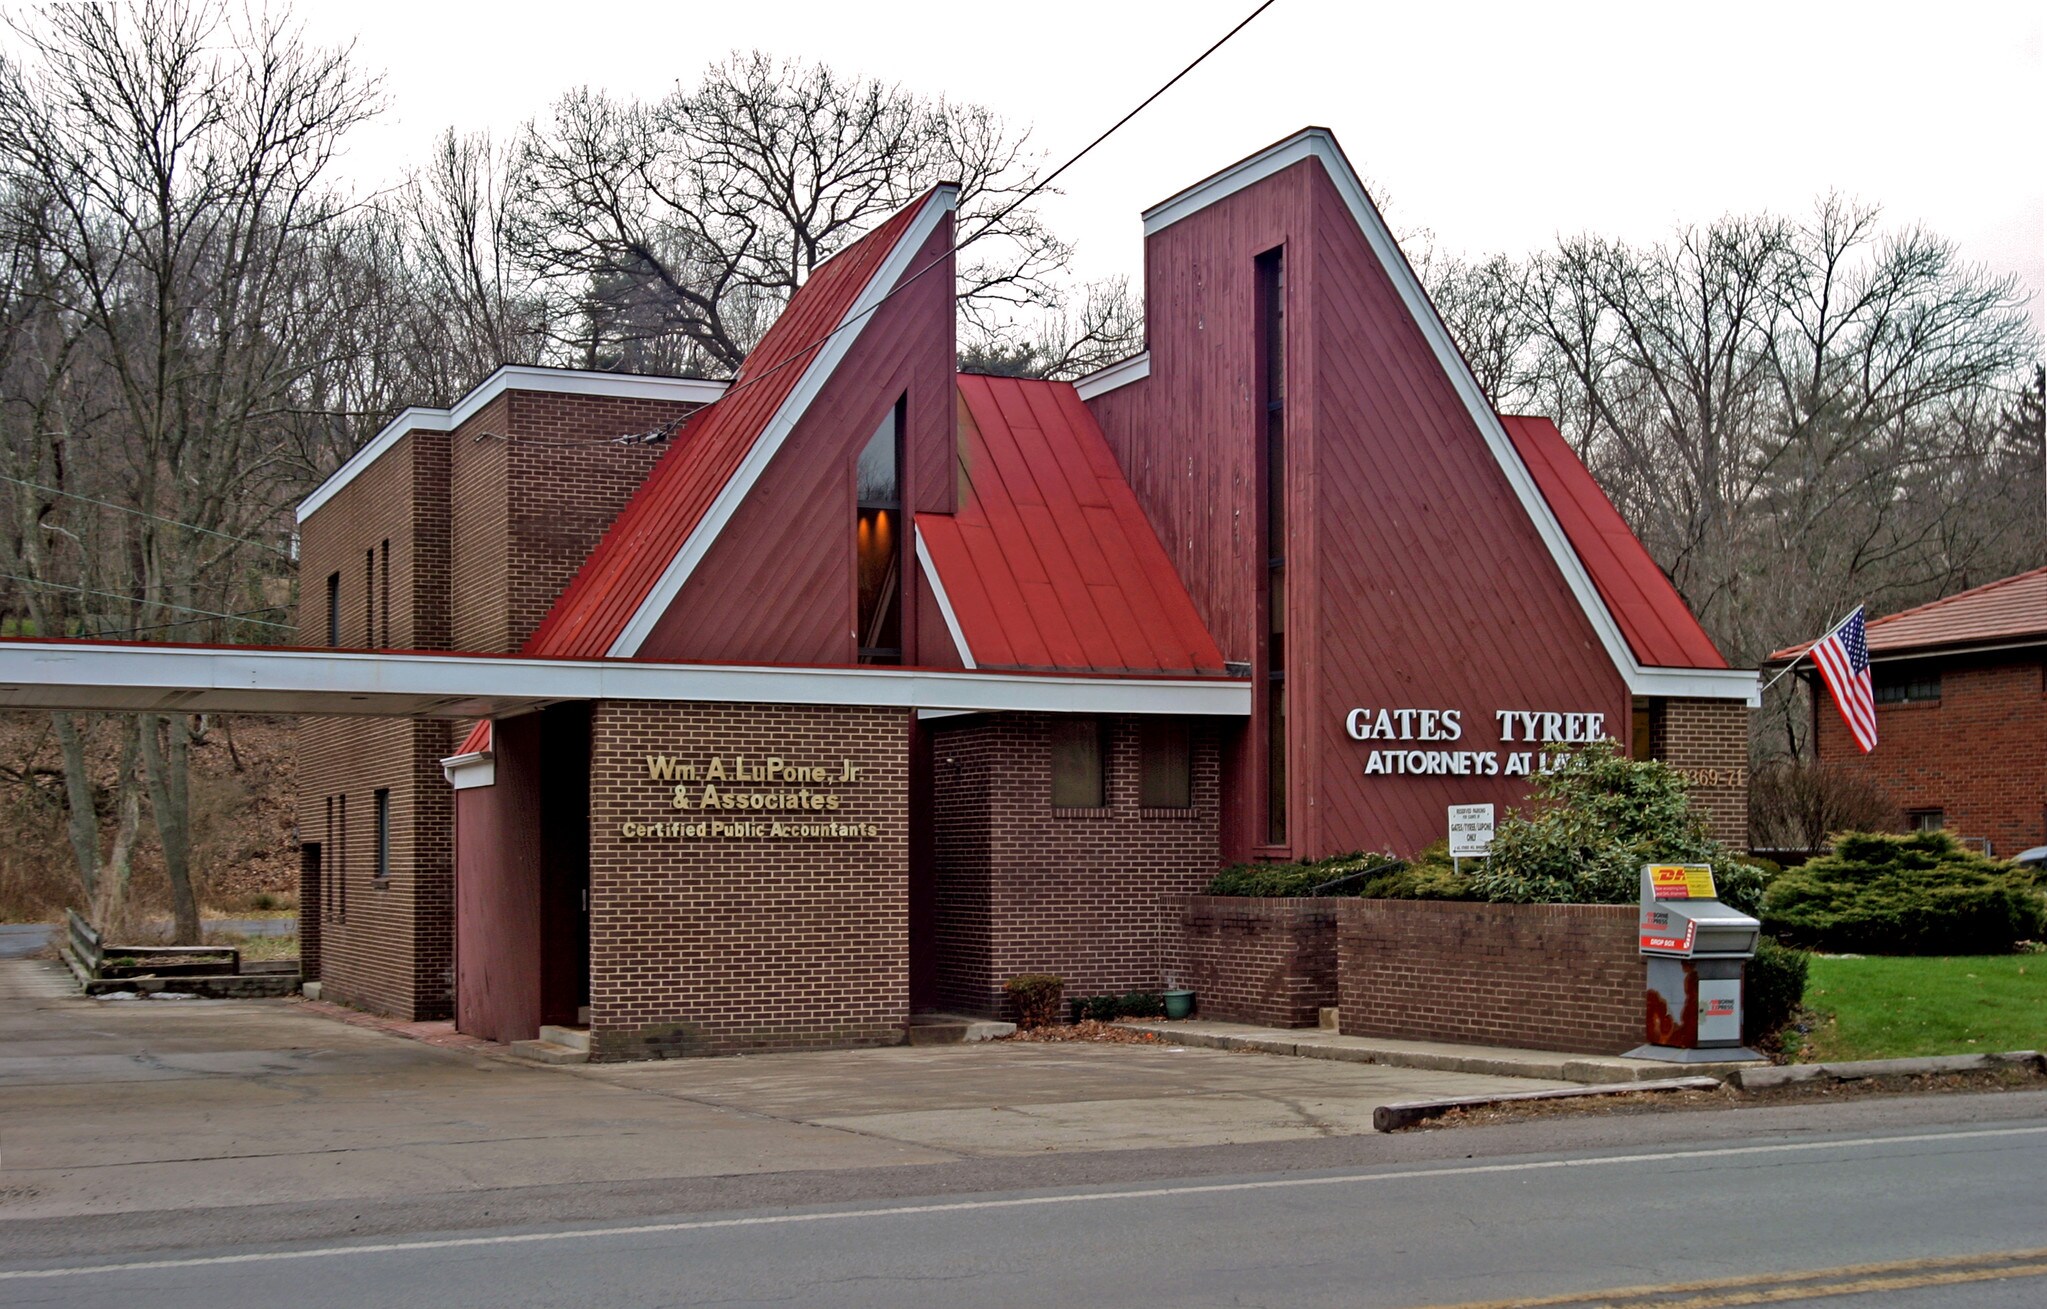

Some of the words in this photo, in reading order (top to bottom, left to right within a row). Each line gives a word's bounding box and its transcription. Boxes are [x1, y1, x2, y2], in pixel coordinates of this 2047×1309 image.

[1345, 708, 1461, 741] GATES
[1496, 710, 1606, 743] TYREE
[646, 755, 701, 781] Wm.
[1364, 750, 1499, 776] ATTORNEYS
[1504, 751, 1532, 776] AT
[1539, 752, 1586, 776] LA
[672, 784, 691, 809] &
[700, 784, 840, 810] Associates
[622, 822, 706, 838] Certified
[711, 821, 764, 837] Public
[770, 822, 877, 837] Accountants
[1658, 869, 1686, 882] DH
